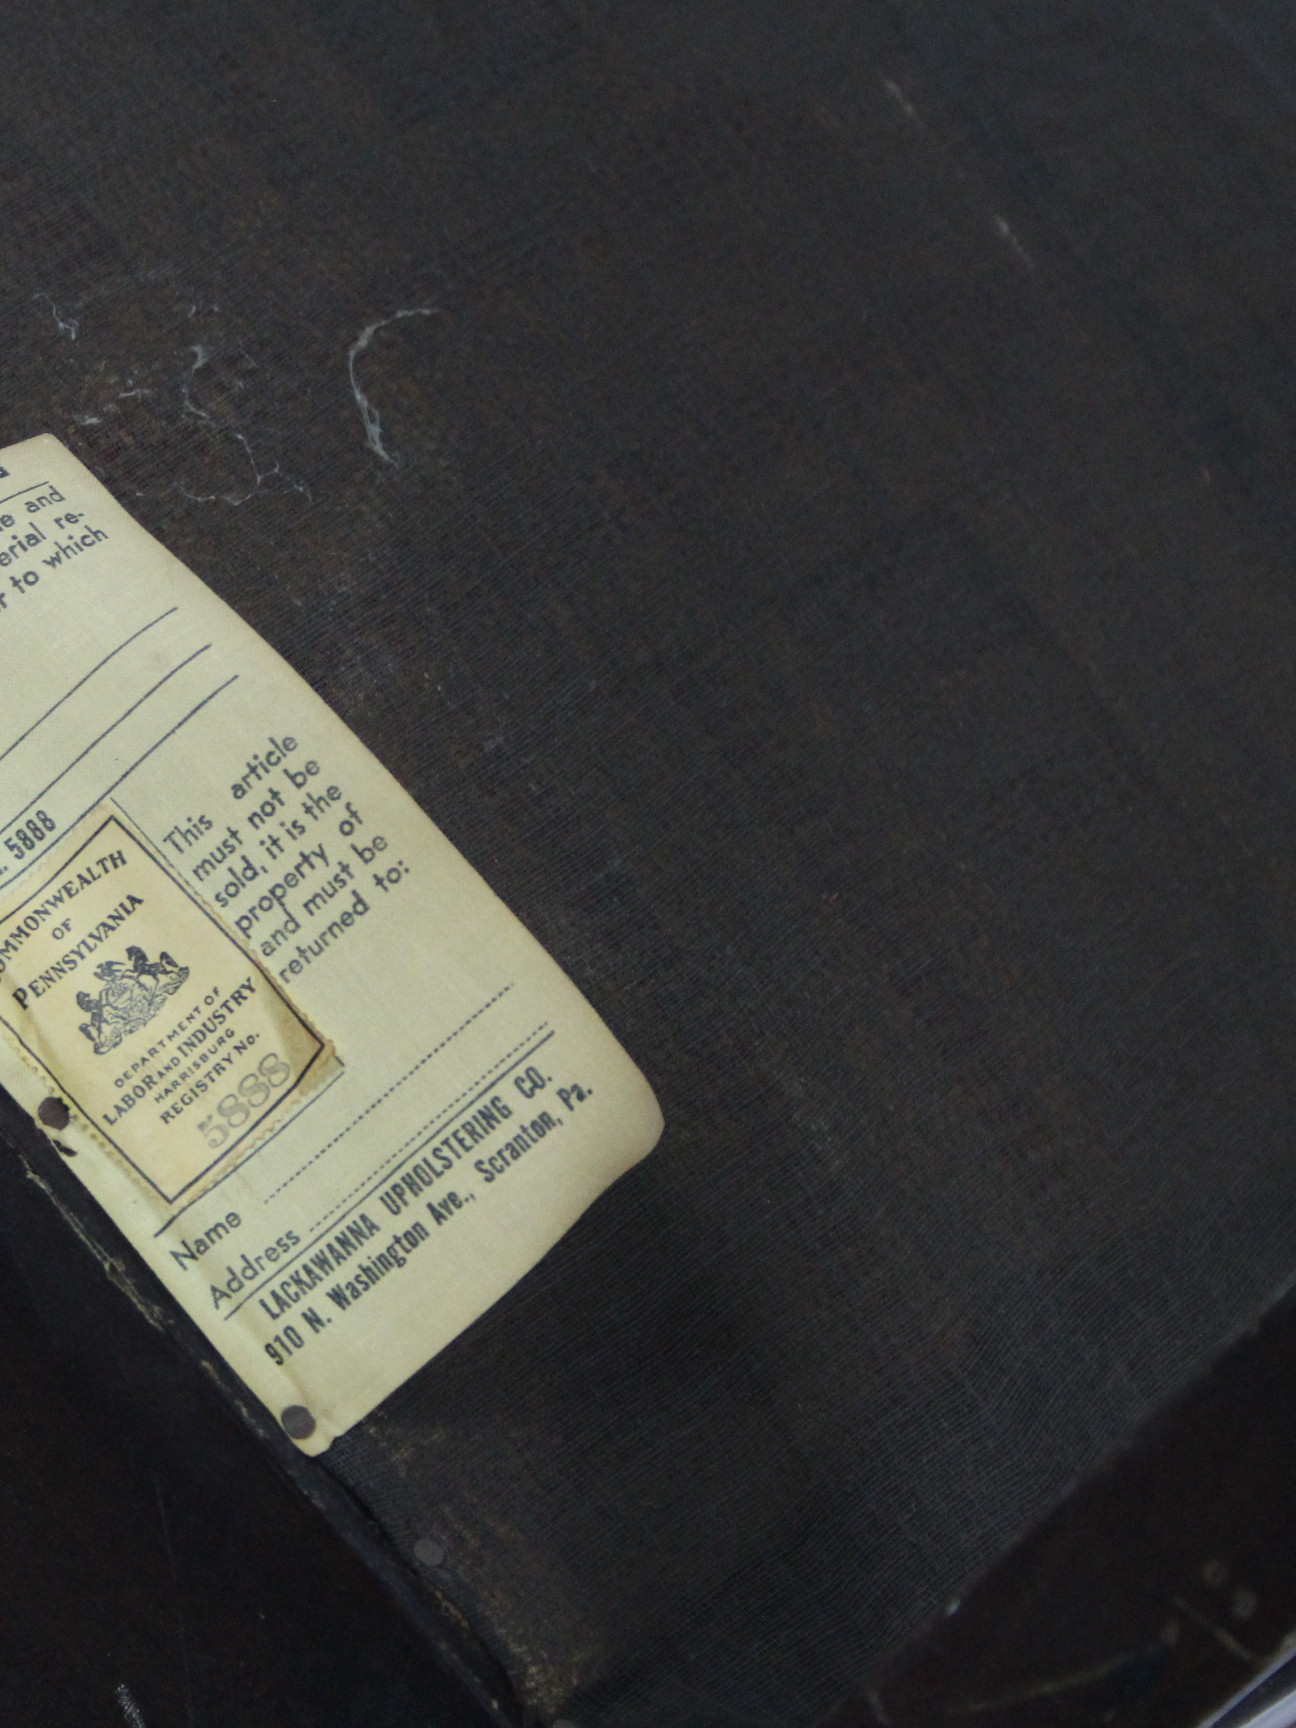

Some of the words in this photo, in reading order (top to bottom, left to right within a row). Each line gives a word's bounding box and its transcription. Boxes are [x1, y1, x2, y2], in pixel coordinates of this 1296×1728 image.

[24, 485, 66, 514] and
[54, 511, 85, 532] re-
[11, 570, 40, 596] to
[43, 526, 109, 571] which
[4, 810, 56, 860] 5888
[163, 814, 213, 854] This
[231, 736, 298, 800] article
[192, 826, 244, 882] must
[247, 787, 286, 830] not
[283, 760, 320, 789] be
[214, 855, 268, 907] sold,
[259, 834, 285, 859] it
[279, 819, 306, 841] is
[302, 785, 342, 821] the
[234, 843, 330, 939] property
[339, 801, 363, 837] of
[260, 904, 301, 957] and
[303, 861, 355, 916] must
[350, 835, 388, 864] be
[12, 894, 145, 1011] PENNSYLVANIA
[51, 918, 72, 940] OF
[279, 890, 370, 984] returned
[372, 860, 410, 892] to:
[102, 1074, 158, 1126] LABOR
[156, 1057, 181, 1079] AND
[177, 976, 256, 1057] INDUSTRY
[114, 1006, 202, 1088] DEPARTMENT
[204, 986, 220, 1006] OF
[153, 1028, 235, 1104] HARRISBURG
[160, 1053, 234, 1124] REGISTRY
[233, 1033, 260, 1056] No.
[197, 1053, 291, 1149] 5888
[169, 1212, 242, 1271] Name
[259, 1213, 381, 1320] LACKAWANNA
[379, 1095, 513, 1216] UPHOLSTERING
[514, 1066, 552, 1098] CO.
[265, 1325, 305, 1366] 910
[301, 1306, 332, 1334] N.
[326, 1221, 430, 1311] Washington
[474, 1111, 563, 1183] Scranton,
[556, 1083, 593, 1112] Pa.
[210, 1230, 301, 1310] Address
